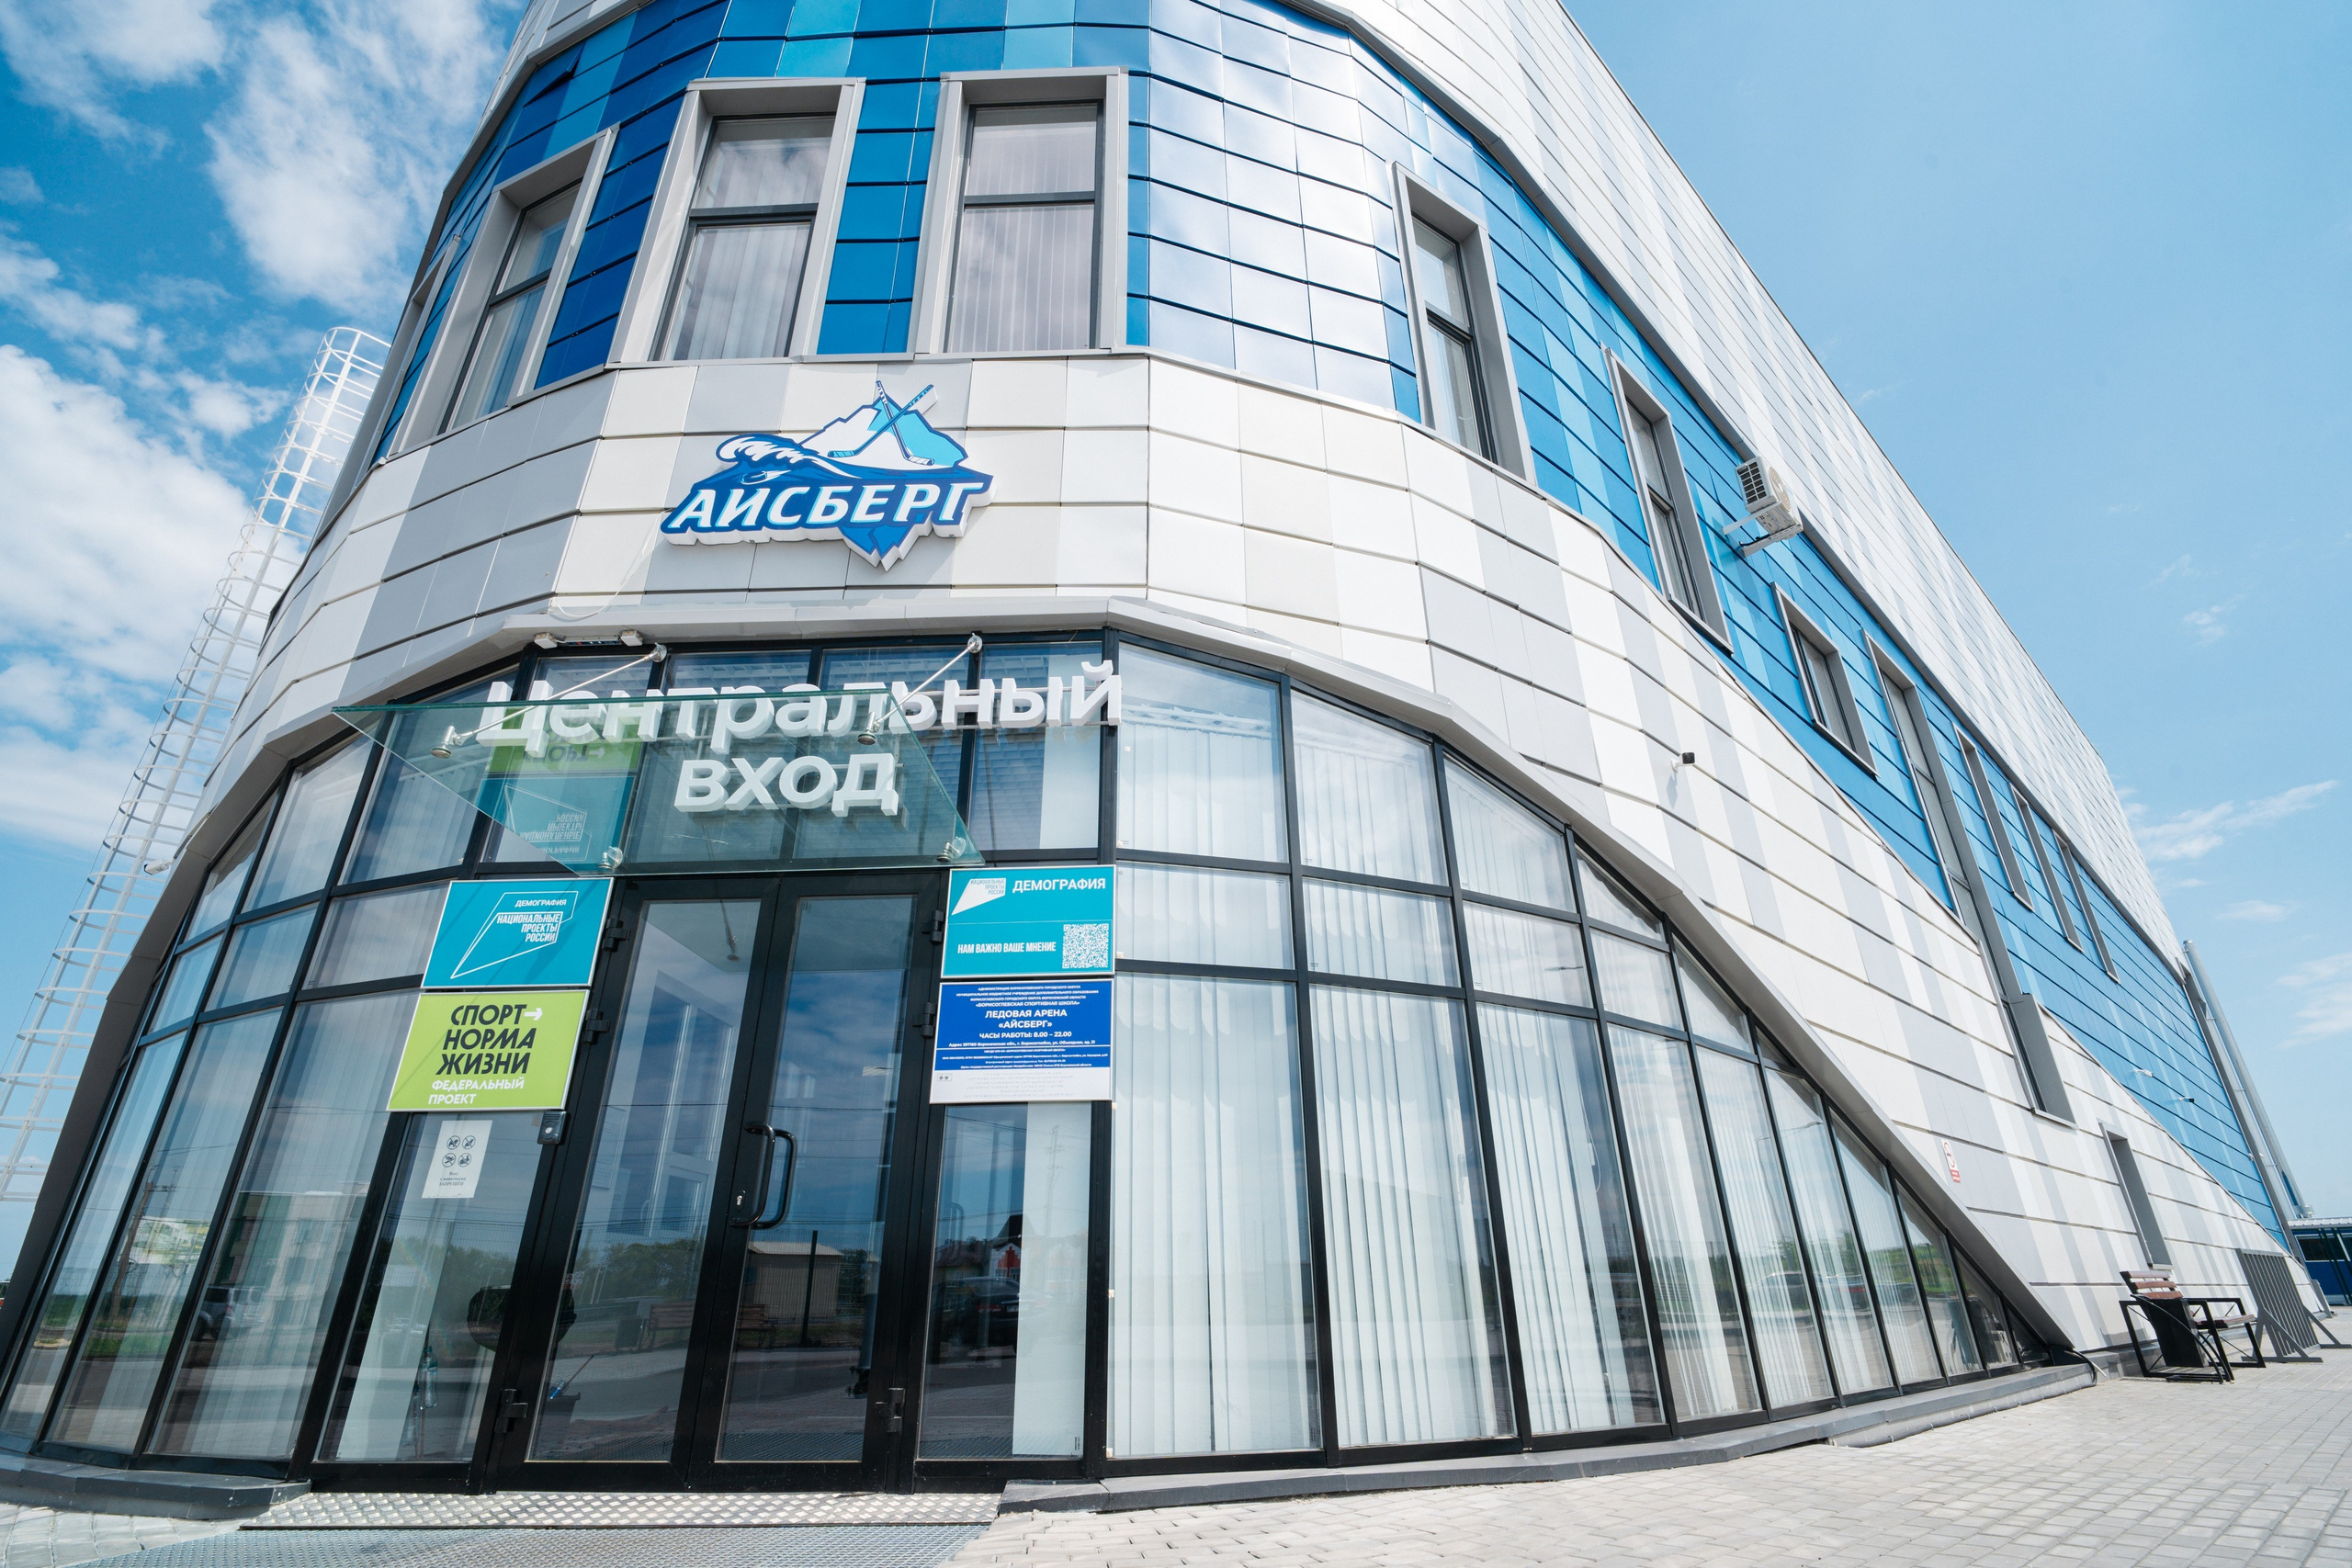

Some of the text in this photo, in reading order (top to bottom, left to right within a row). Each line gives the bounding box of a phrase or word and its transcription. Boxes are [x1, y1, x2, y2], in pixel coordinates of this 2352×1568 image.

[476, 660, 1123, 758] Центральный
[1012, 878, 1106, 894] ДЕМОГРАФИЯ
[514, 899, 567, 908] ДЕМОГРАФИЯ
[497, 913, 560, 924] НАЦИОНАЛЬНЫЕ
[521, 923, 559, 932] ПРОЕКТЫ
[525, 933, 556, 942] РОССИИ
[957, 942, 1057, 953] НАМ ВАЖНО ВАШЕ МНЕНИЕ
[451, 1004, 527, 1025] СПОРТ
[985, 1010, 1032, 1019] ЛЕДОВАЯ
[999, 1020, 1052, 1029] «АЙСБЕРГ»
[443, 1028, 537, 1050] НОРМА
[435, 1053, 531, 1075] ЖИЗНИ
[432, 1077, 525, 1091] ФЕДЕРАЛЬНЫЙ
[428, 1094, 477, 1104] ПРОЕКТ
